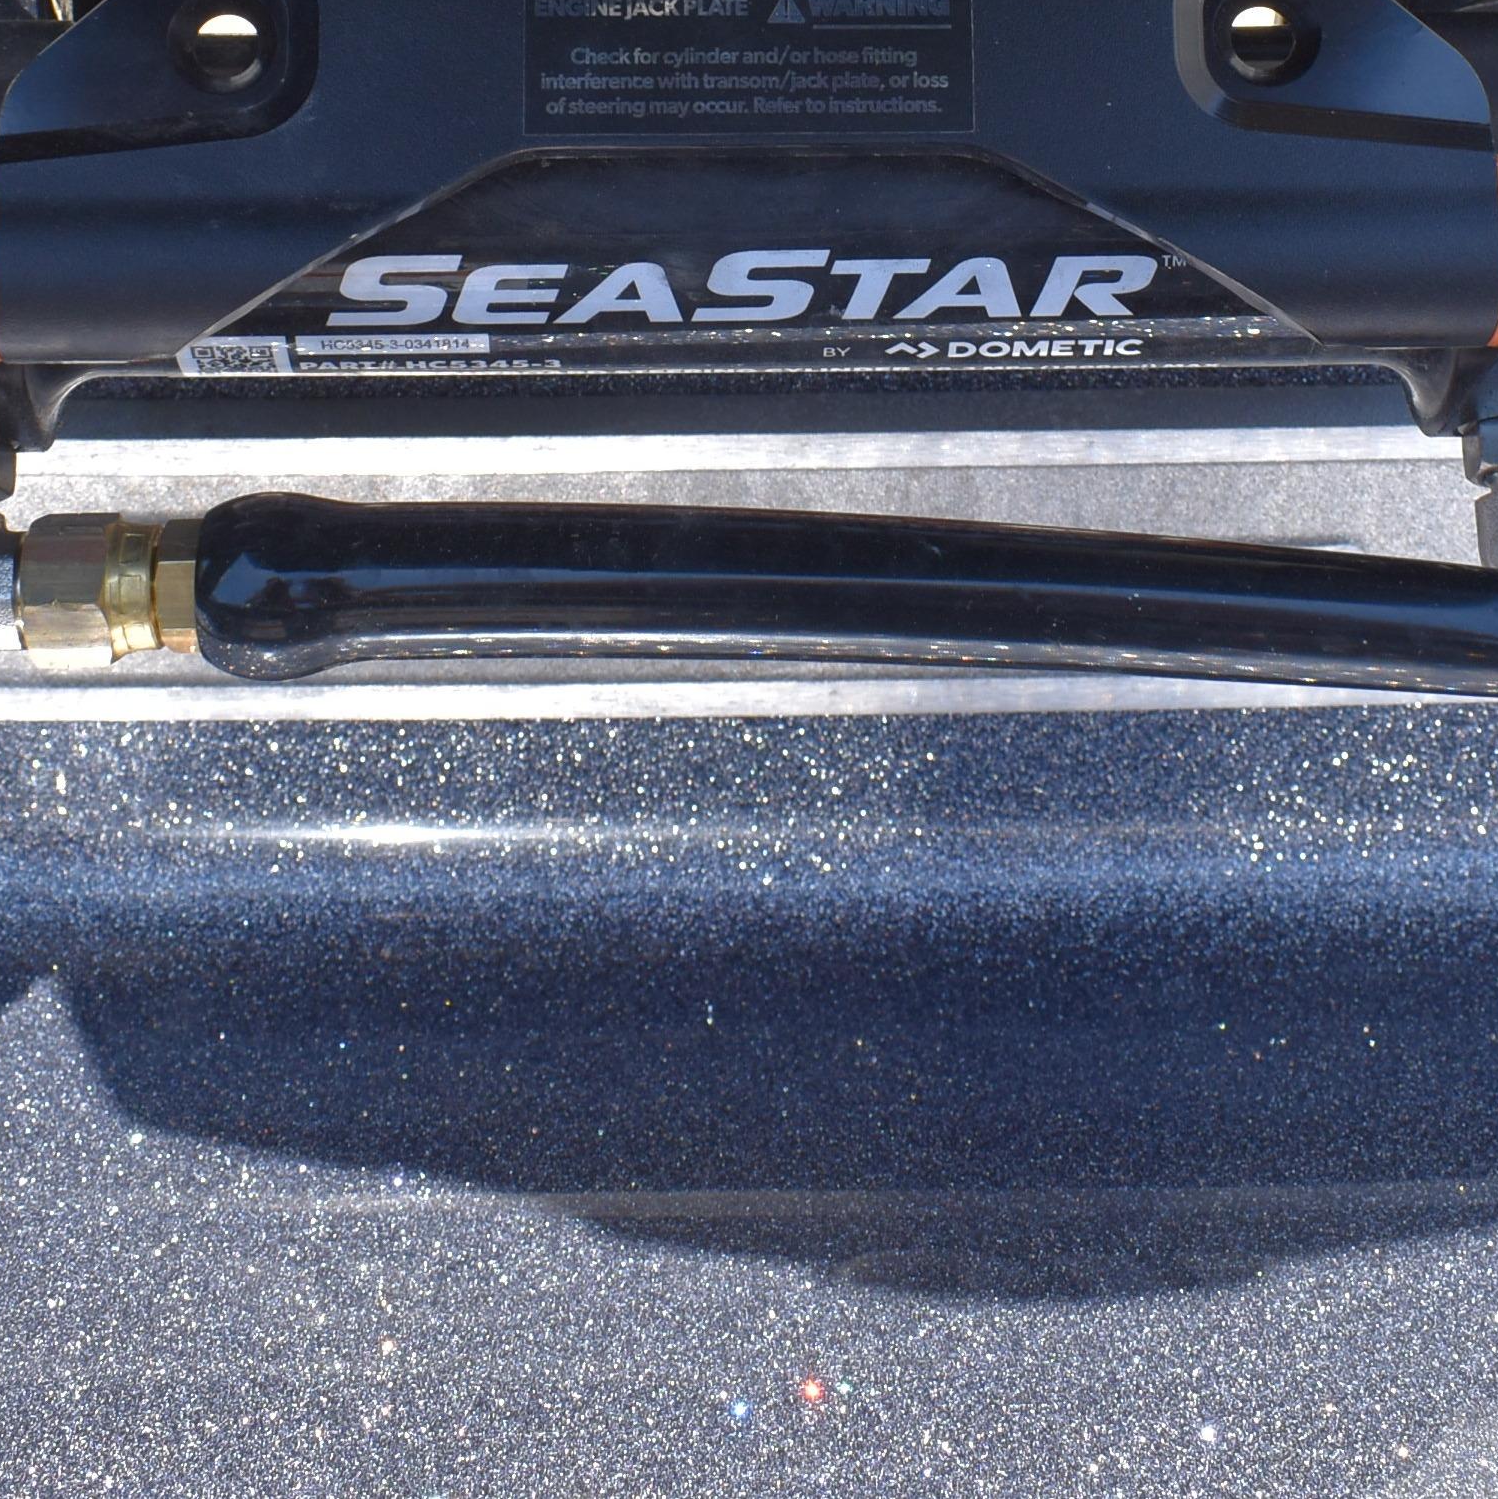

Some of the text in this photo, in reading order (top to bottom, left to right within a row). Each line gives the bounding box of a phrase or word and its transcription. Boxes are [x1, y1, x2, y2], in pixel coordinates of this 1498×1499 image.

[570, 45, 918, 68] Check for cylinder and/or hose fitting
[540, 69, 950, 93] interference with transom/jack plate, or loss
[545, 96, 944, 118] of steering may occur. Refer to instructions.
[325, 248, 1159, 327] SEASTAR
[823, 339, 1144, 358] BY DOMETIC
